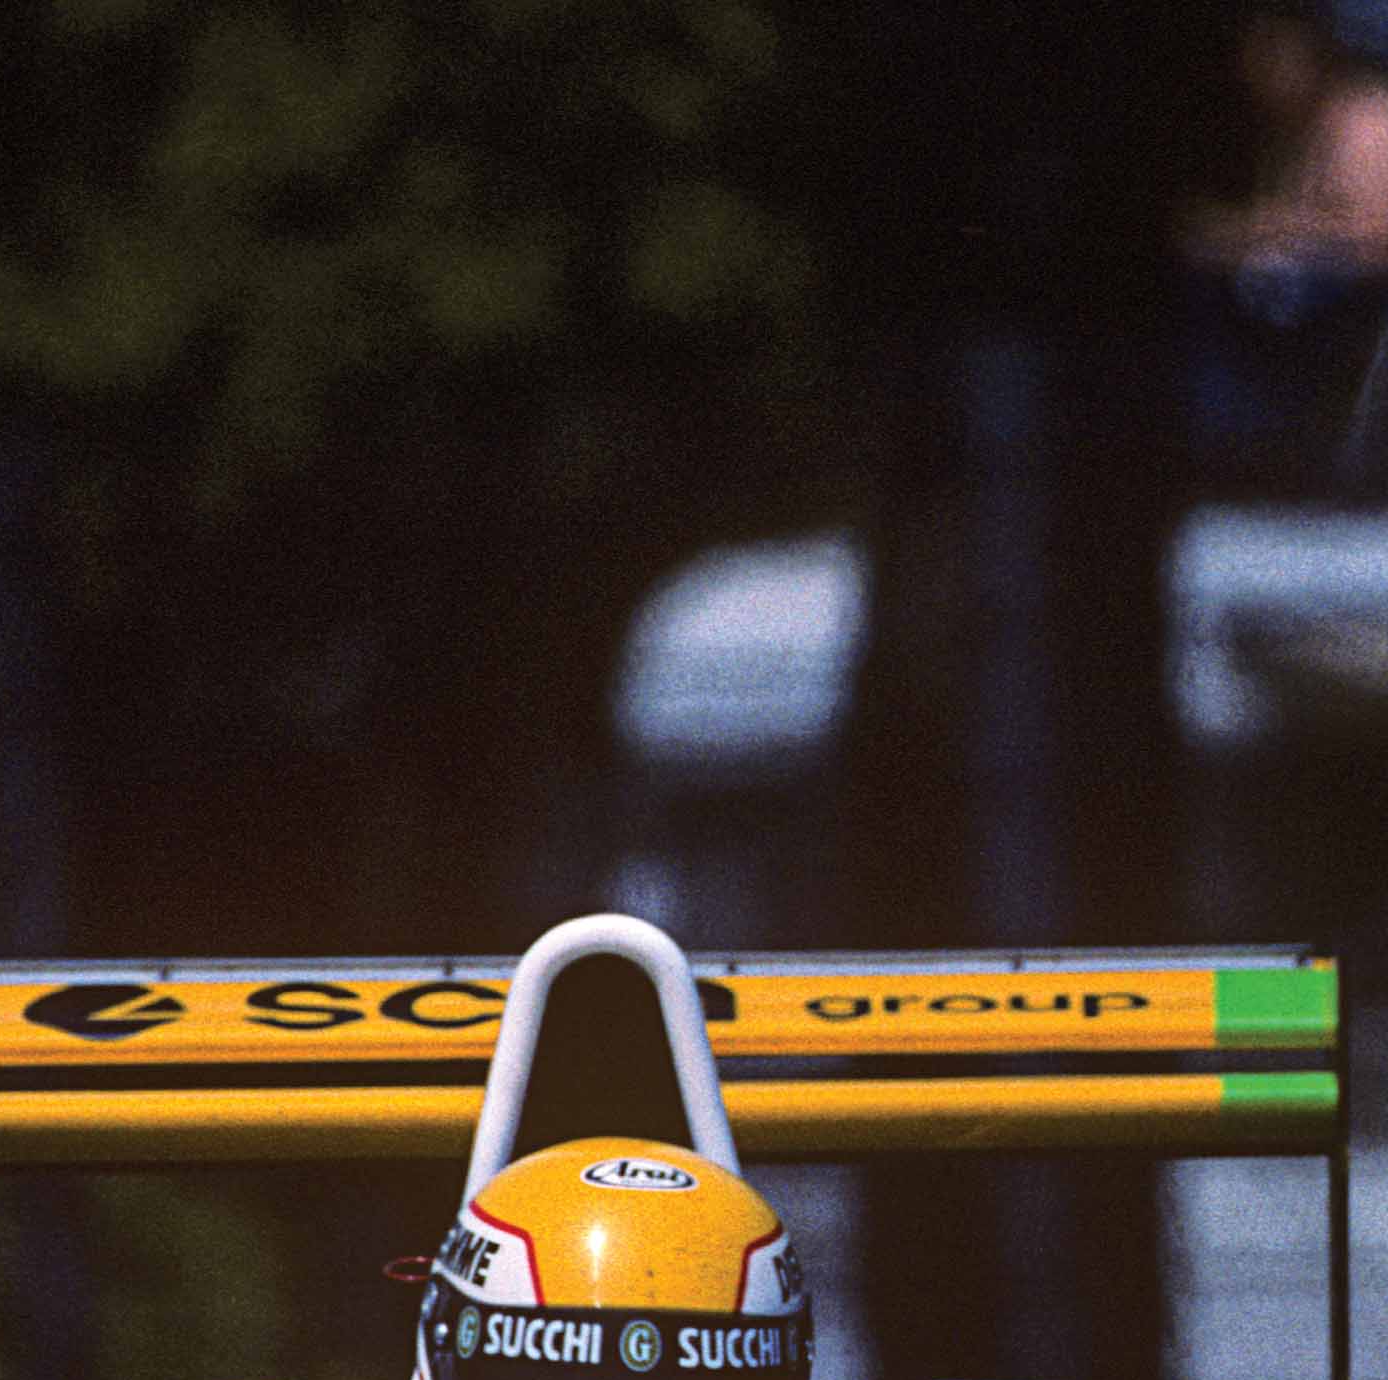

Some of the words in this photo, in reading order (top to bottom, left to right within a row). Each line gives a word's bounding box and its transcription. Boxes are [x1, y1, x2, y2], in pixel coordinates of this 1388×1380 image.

[805, 992, 1149, 1020] group
[483, 1313, 602, 1364] SUCCHI
[678, 1327, 780, 1369] SUCCHI
